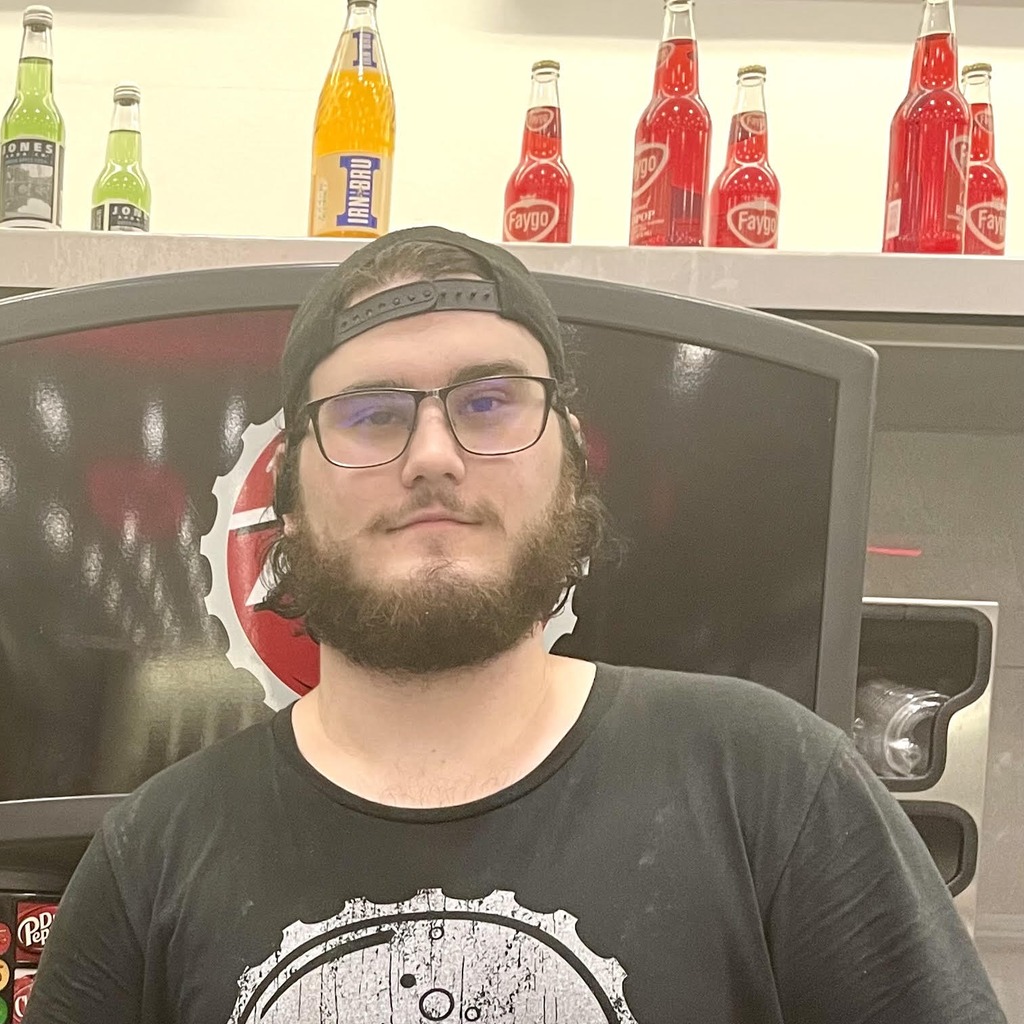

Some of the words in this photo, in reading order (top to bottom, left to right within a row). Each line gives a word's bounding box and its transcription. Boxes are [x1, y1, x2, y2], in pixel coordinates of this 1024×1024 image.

[509, 210, 549, 232] Faygo
[739, 211, 777, 236] Faygo
[18, 916, 50, 947] Pep
